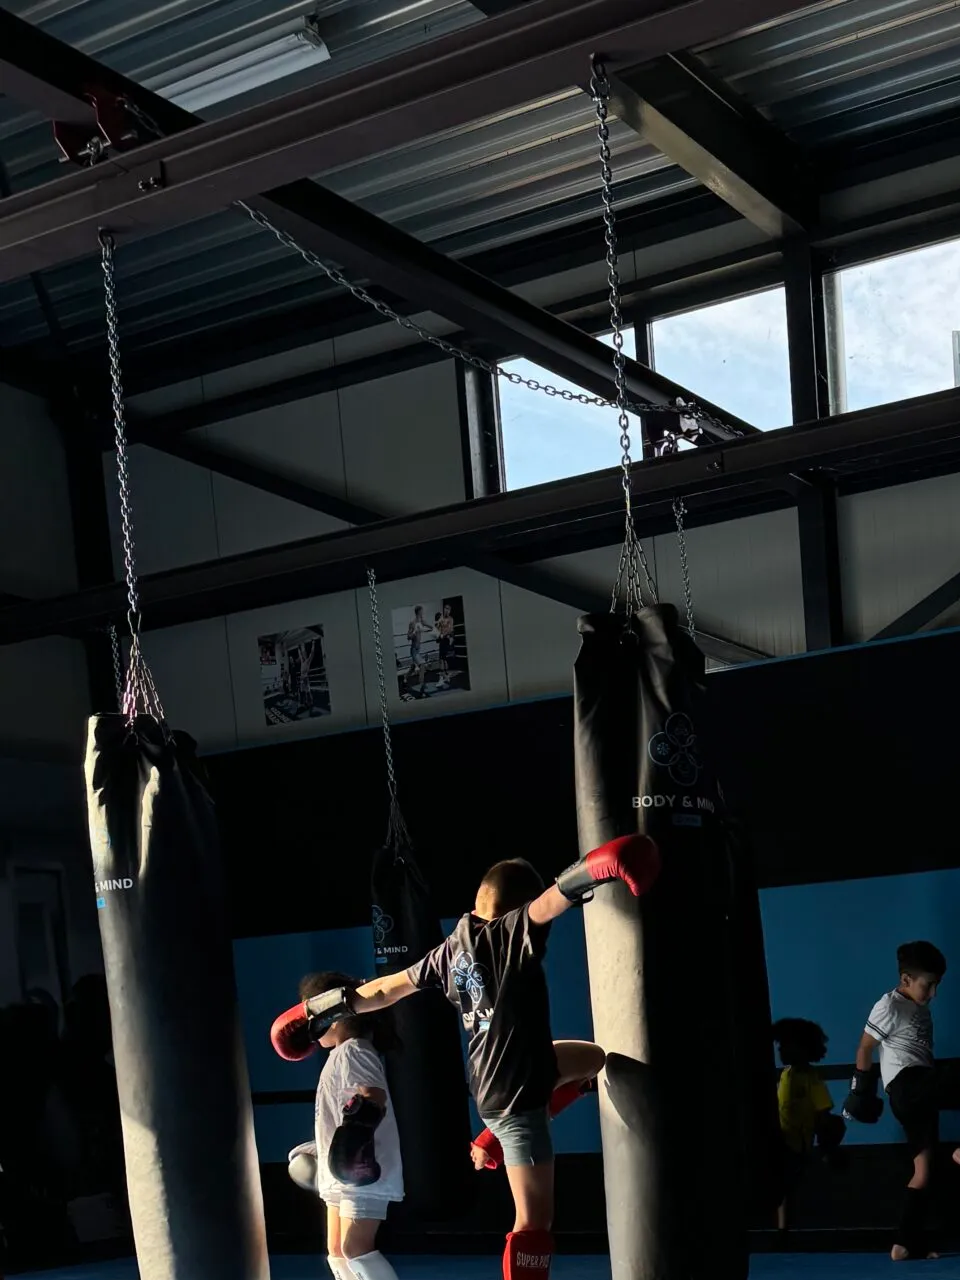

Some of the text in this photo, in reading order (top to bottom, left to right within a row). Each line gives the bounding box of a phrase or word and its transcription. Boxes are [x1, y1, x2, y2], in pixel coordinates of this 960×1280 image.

[632, 794, 676, 809] BODY
[682, 795, 693, 808] &
[100, 877, 134, 893] MIND
[383, 945, 409, 955] MIND
[516, 1251, 539, 1268] SUPER
